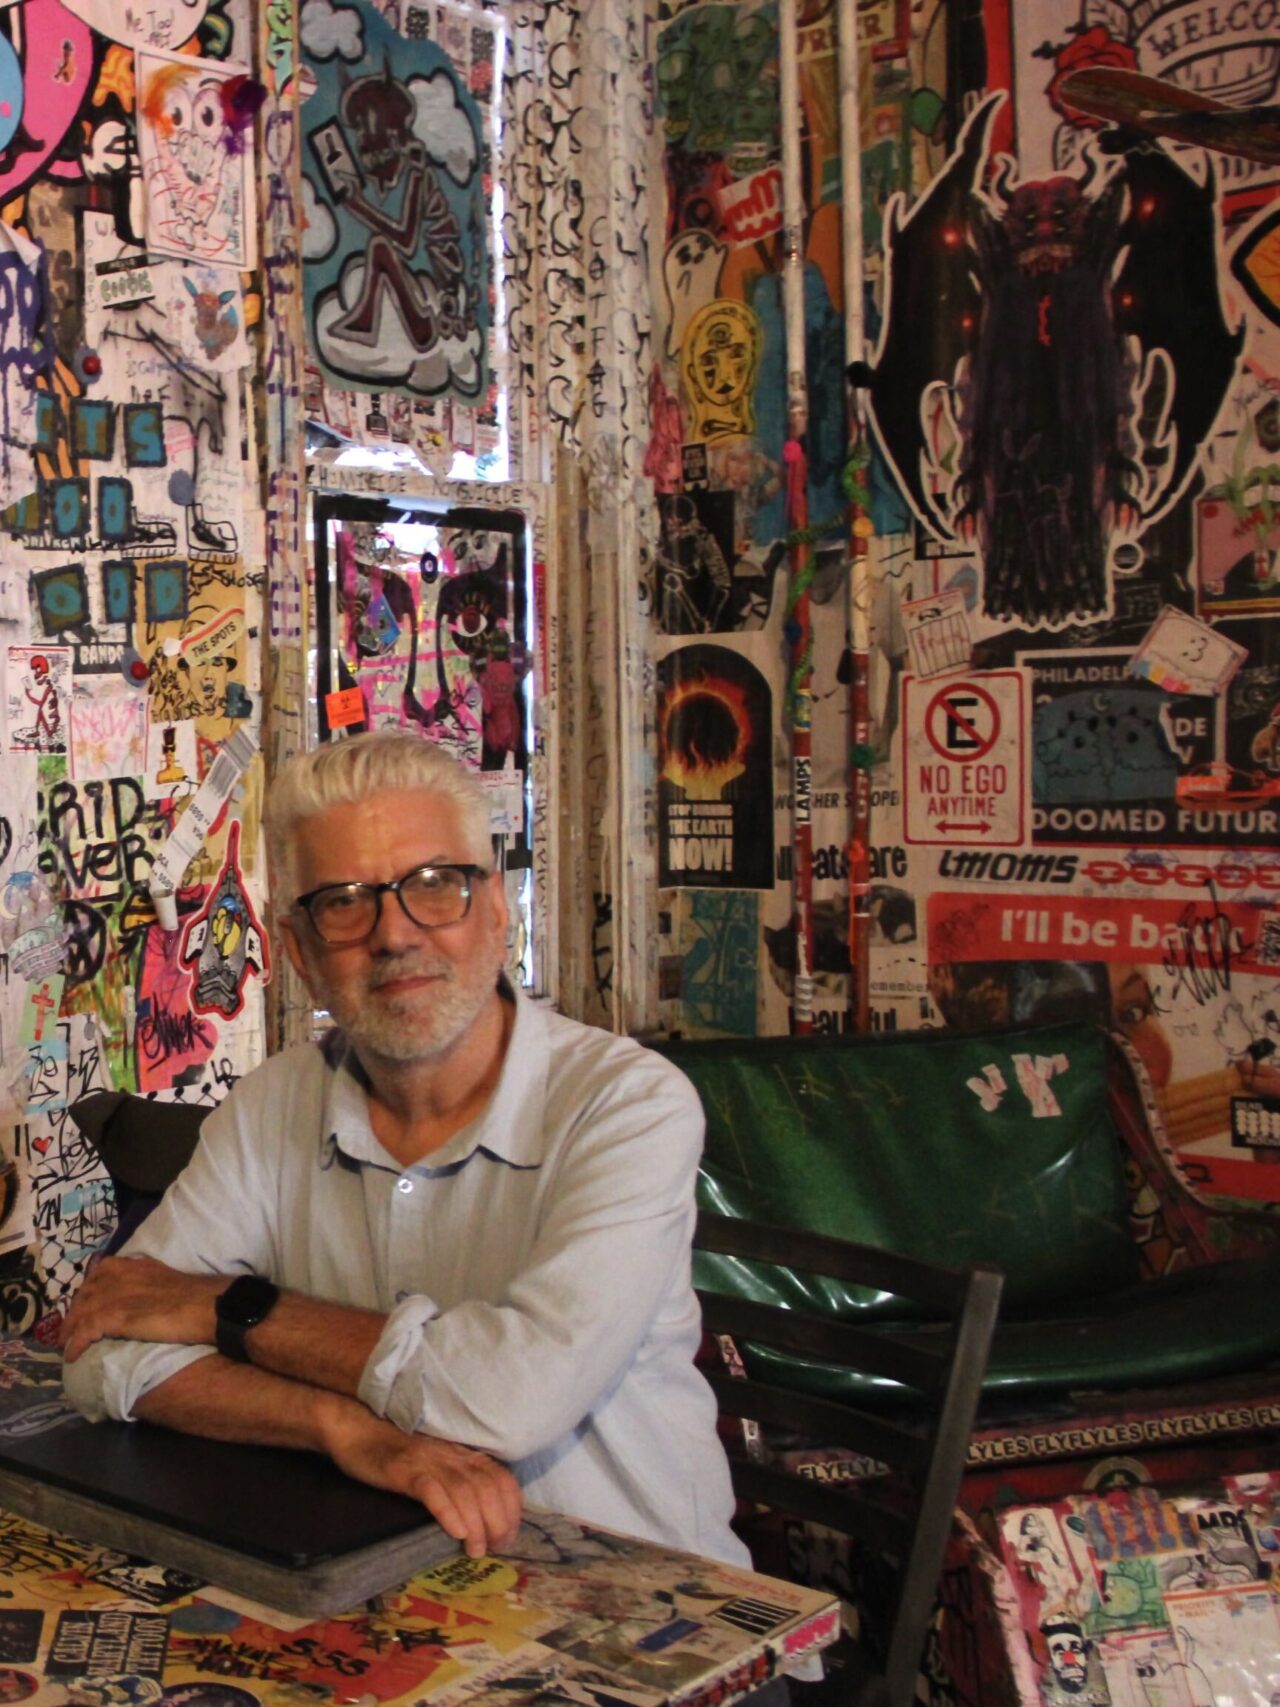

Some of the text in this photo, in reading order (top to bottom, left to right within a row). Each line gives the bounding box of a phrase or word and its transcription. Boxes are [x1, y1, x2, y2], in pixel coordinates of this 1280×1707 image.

[1147, 0, 1280, 60] WELCO
[192, 622, 239, 657] THE SPOTS
[795, 756, 812, 824] LAMPS
[921, 763, 1007, 795] NO EGO
[926, 795, 997, 818] ANYTIME
[1031, 809, 1166, 831] DOOMED
[669, 819, 734, 836] THE EARTH
[668, 837, 734, 872] NOW!
[1001, 909, 1119, 948] I'll be
[1034, 1423, 1144, 1456] FLYFLYLES
[1145, 1410, 1254, 1442] FLYFLYLES
[52, 1620, 96, 1664] CALVIN
[86, 1612, 134, 1677] MARYLAND
[125, 1616, 168, 1674] TATTOOS
